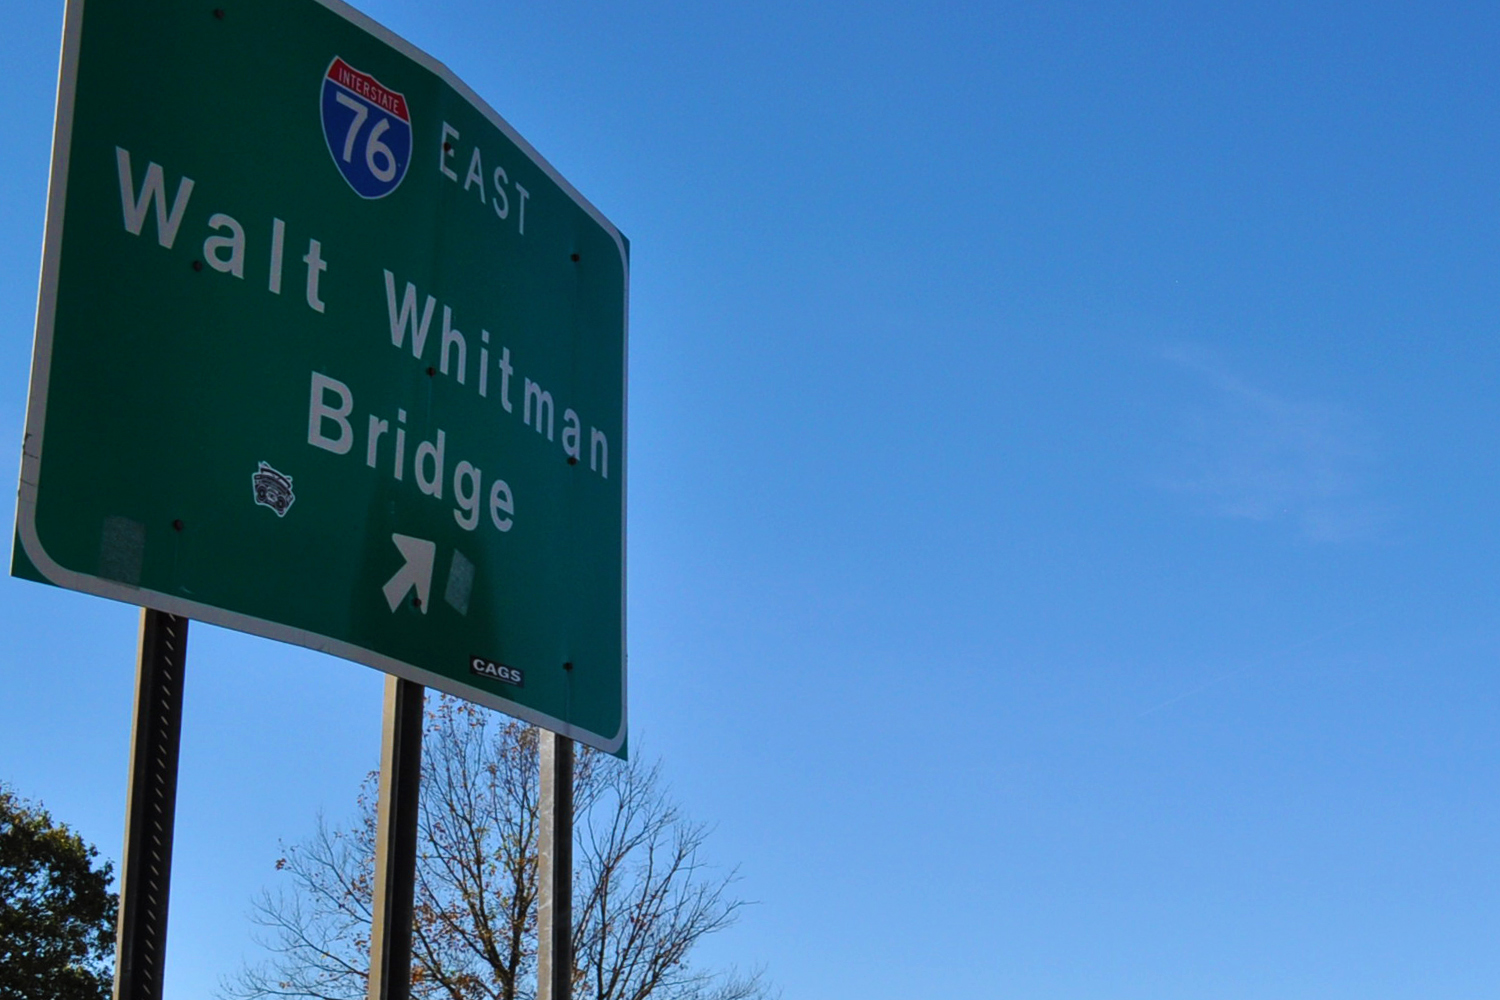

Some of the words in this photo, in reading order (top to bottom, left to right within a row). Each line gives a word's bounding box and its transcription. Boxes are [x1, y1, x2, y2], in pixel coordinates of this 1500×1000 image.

[335, 90, 397, 183] 76
[338, 67, 400, 114] INTERSTATE
[439, 120, 530, 236] EAST
[115, 145, 328, 314] Walt
[383, 268, 609, 480] Whitman
[307, 370, 515, 533] Bridge
[472, 658, 522, 682] CAGS
